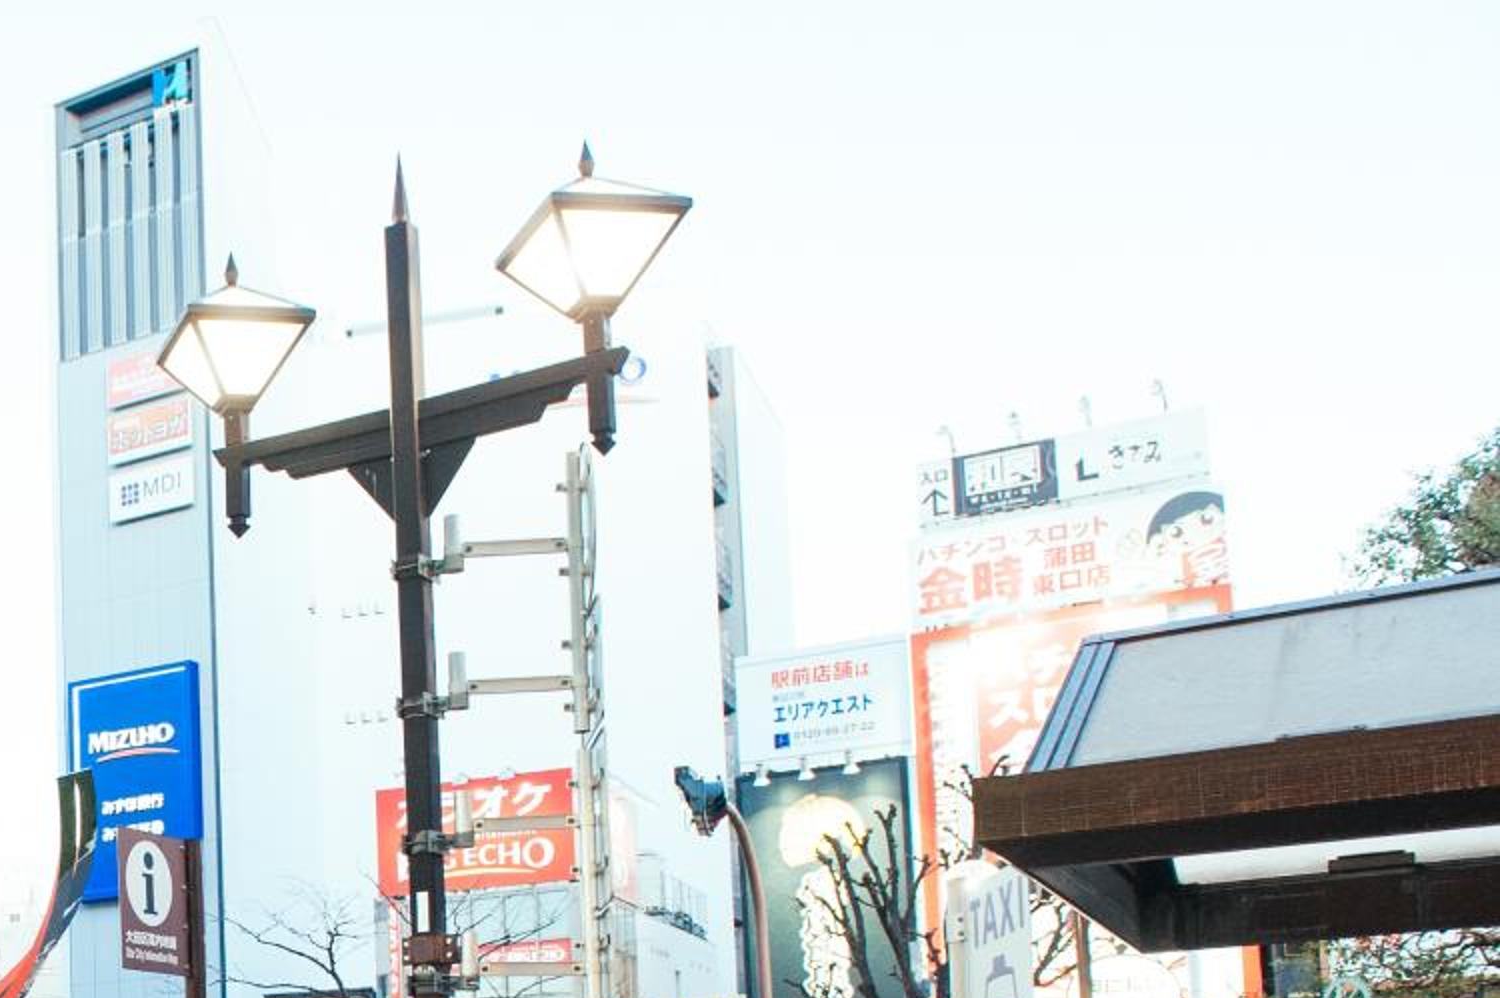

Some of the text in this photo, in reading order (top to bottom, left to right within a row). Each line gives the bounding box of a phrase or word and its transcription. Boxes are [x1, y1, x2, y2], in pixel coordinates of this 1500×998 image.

[142, 470, 182, 498] MDI
[1043, 541, 1096, 570] 蒲田
[919, 555, 1024, 615] 金時
[773, 694, 873, 723] エリアクエスト
[87, 722, 176, 755] MIZUHO
[462, 836, 555, 870] ECHO
[969, 876, 1027, 949] TAXI
